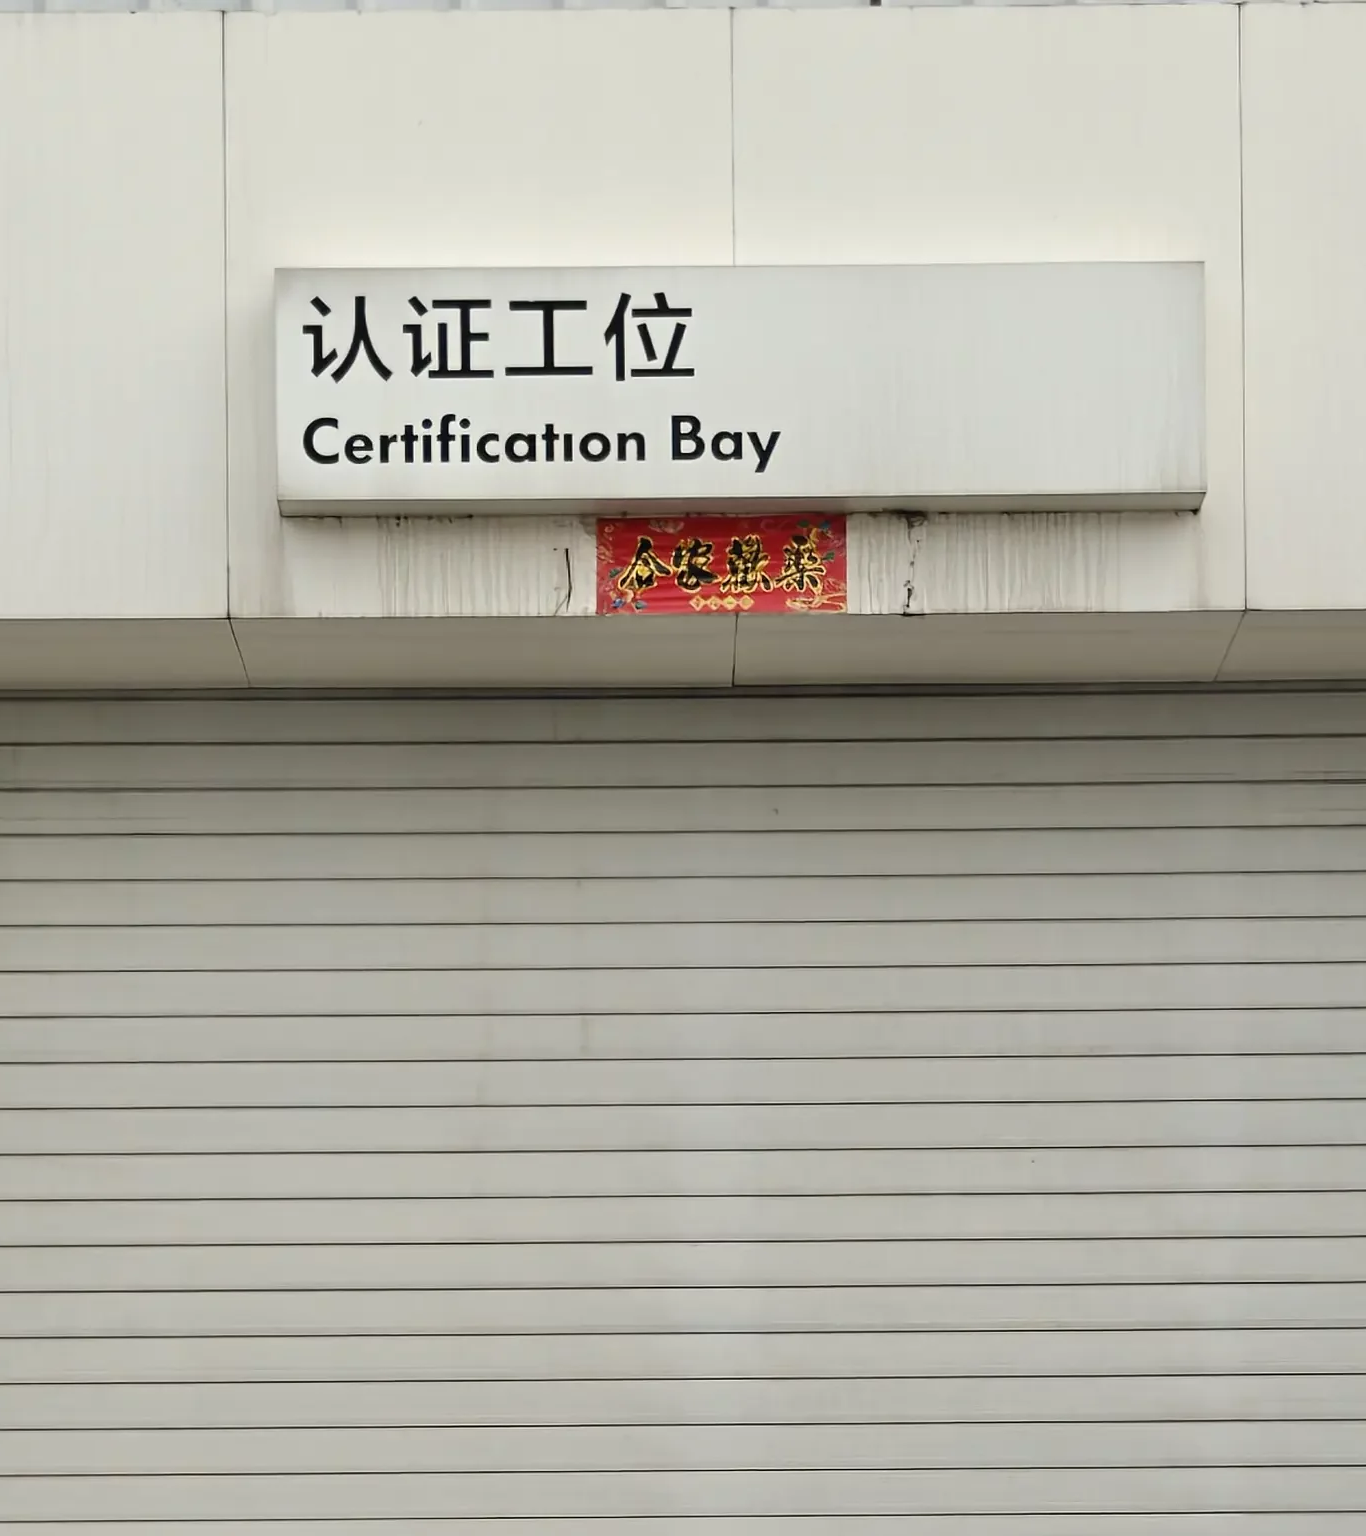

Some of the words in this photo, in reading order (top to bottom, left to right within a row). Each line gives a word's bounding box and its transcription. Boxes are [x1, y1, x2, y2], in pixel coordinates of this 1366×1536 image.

[302, 292, 695, 383] 认证工位
[302, 413, 646, 465] Certification
[671, 415, 781, 473] Bay
